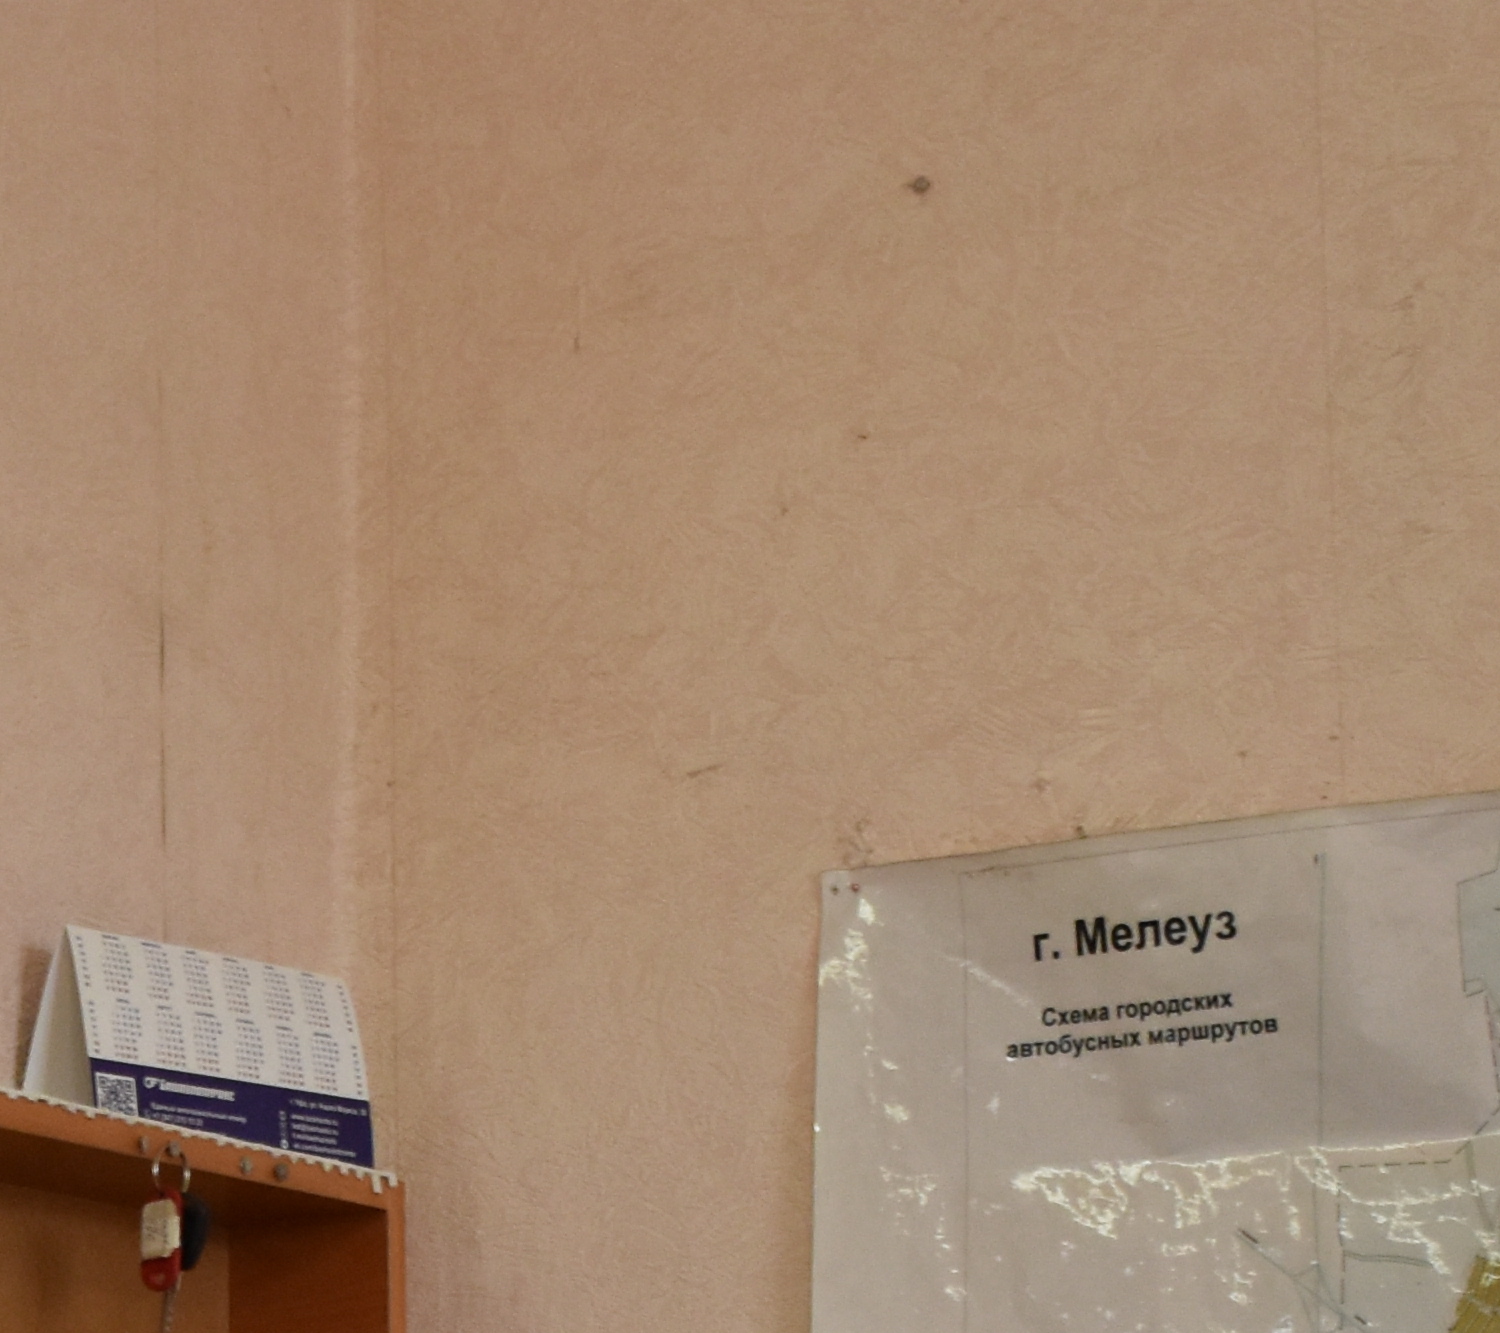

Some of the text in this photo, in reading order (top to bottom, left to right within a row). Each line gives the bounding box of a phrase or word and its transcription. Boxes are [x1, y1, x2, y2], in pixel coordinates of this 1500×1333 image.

[1032, 910, 1238, 962] г. Мелеуз
[1041, 992, 1233, 1027] Схема городских
[1006, 1016, 1278, 1059] автобусных маршрутов
